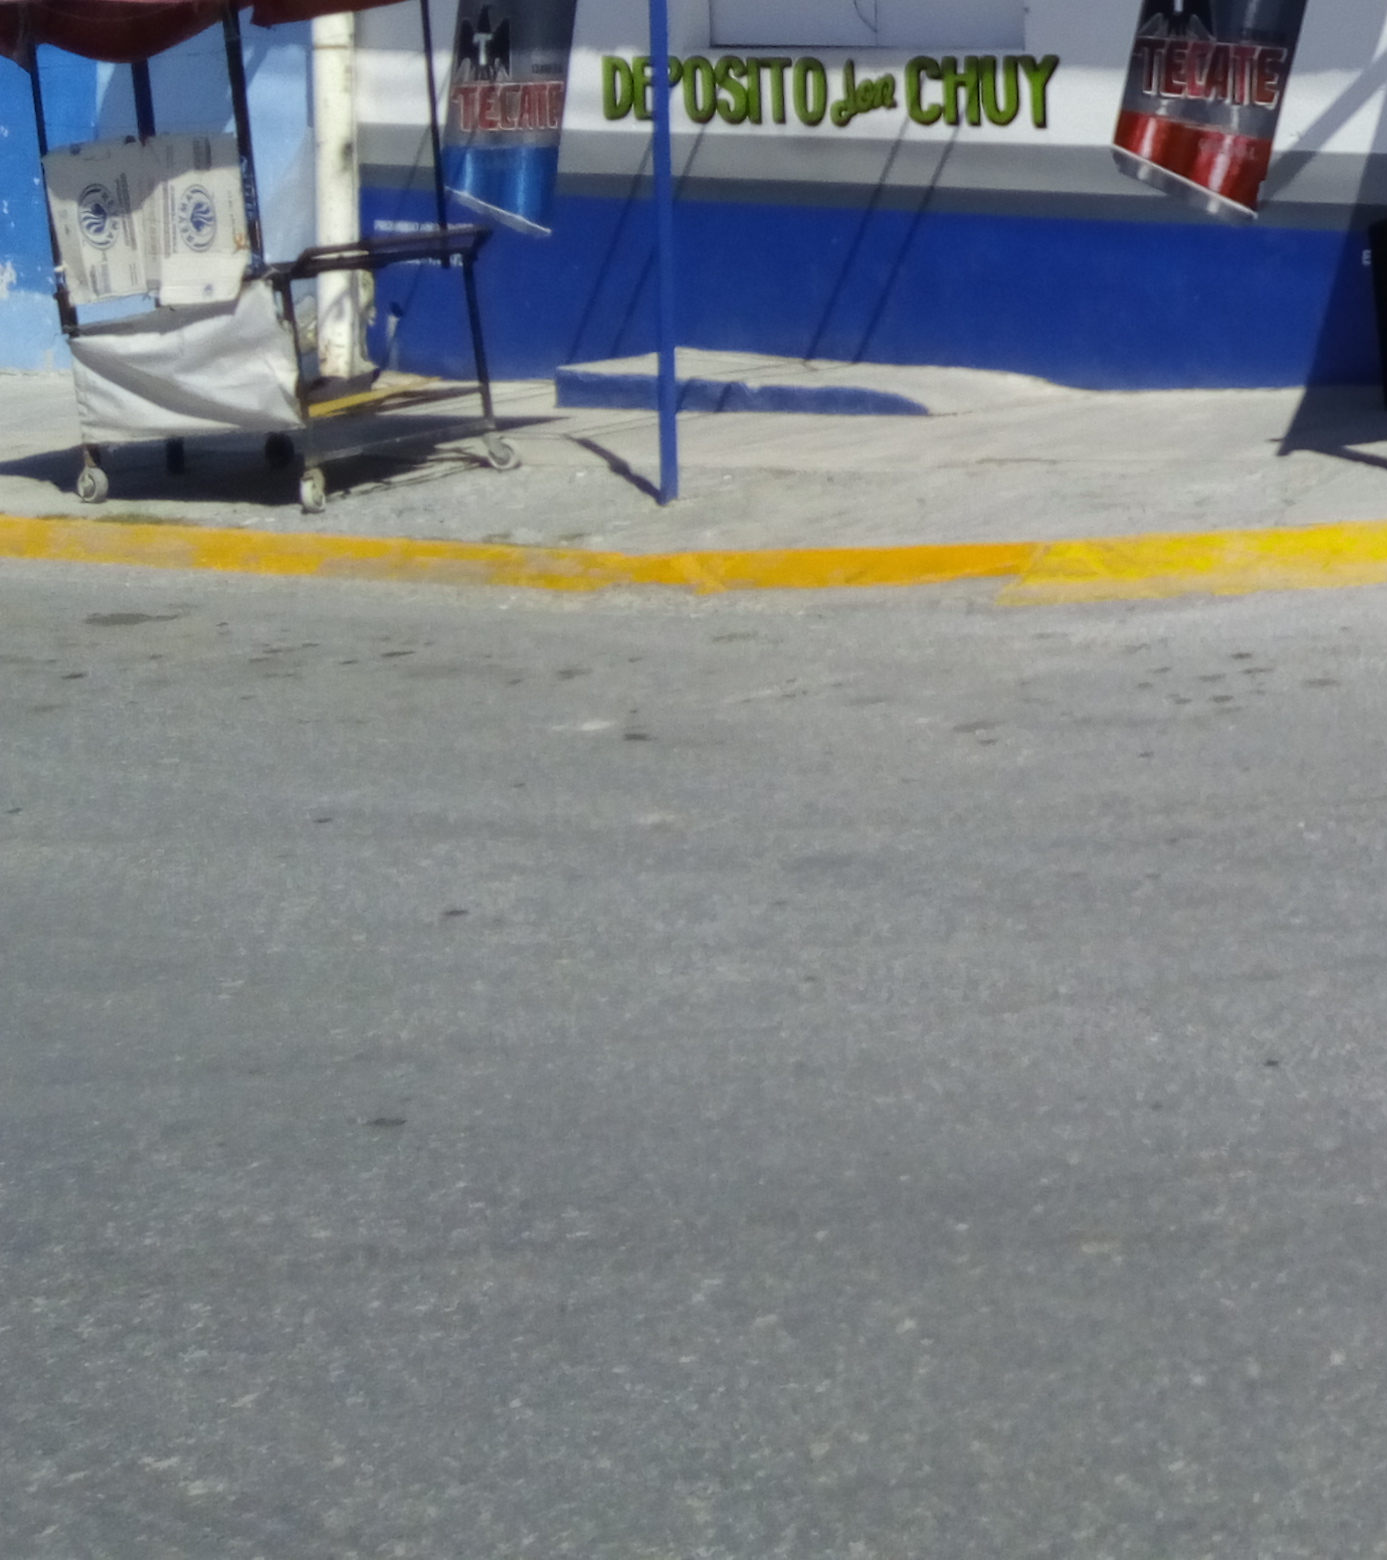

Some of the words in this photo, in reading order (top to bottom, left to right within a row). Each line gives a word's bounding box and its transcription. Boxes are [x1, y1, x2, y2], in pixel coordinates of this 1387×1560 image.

[452, 80, 564, 132] TECATE
[601, 54, 828, 126] DEPOSITO
[905, 53, 1061, 129] CHUY
[1133, 37, 1288, 110] TECATE
